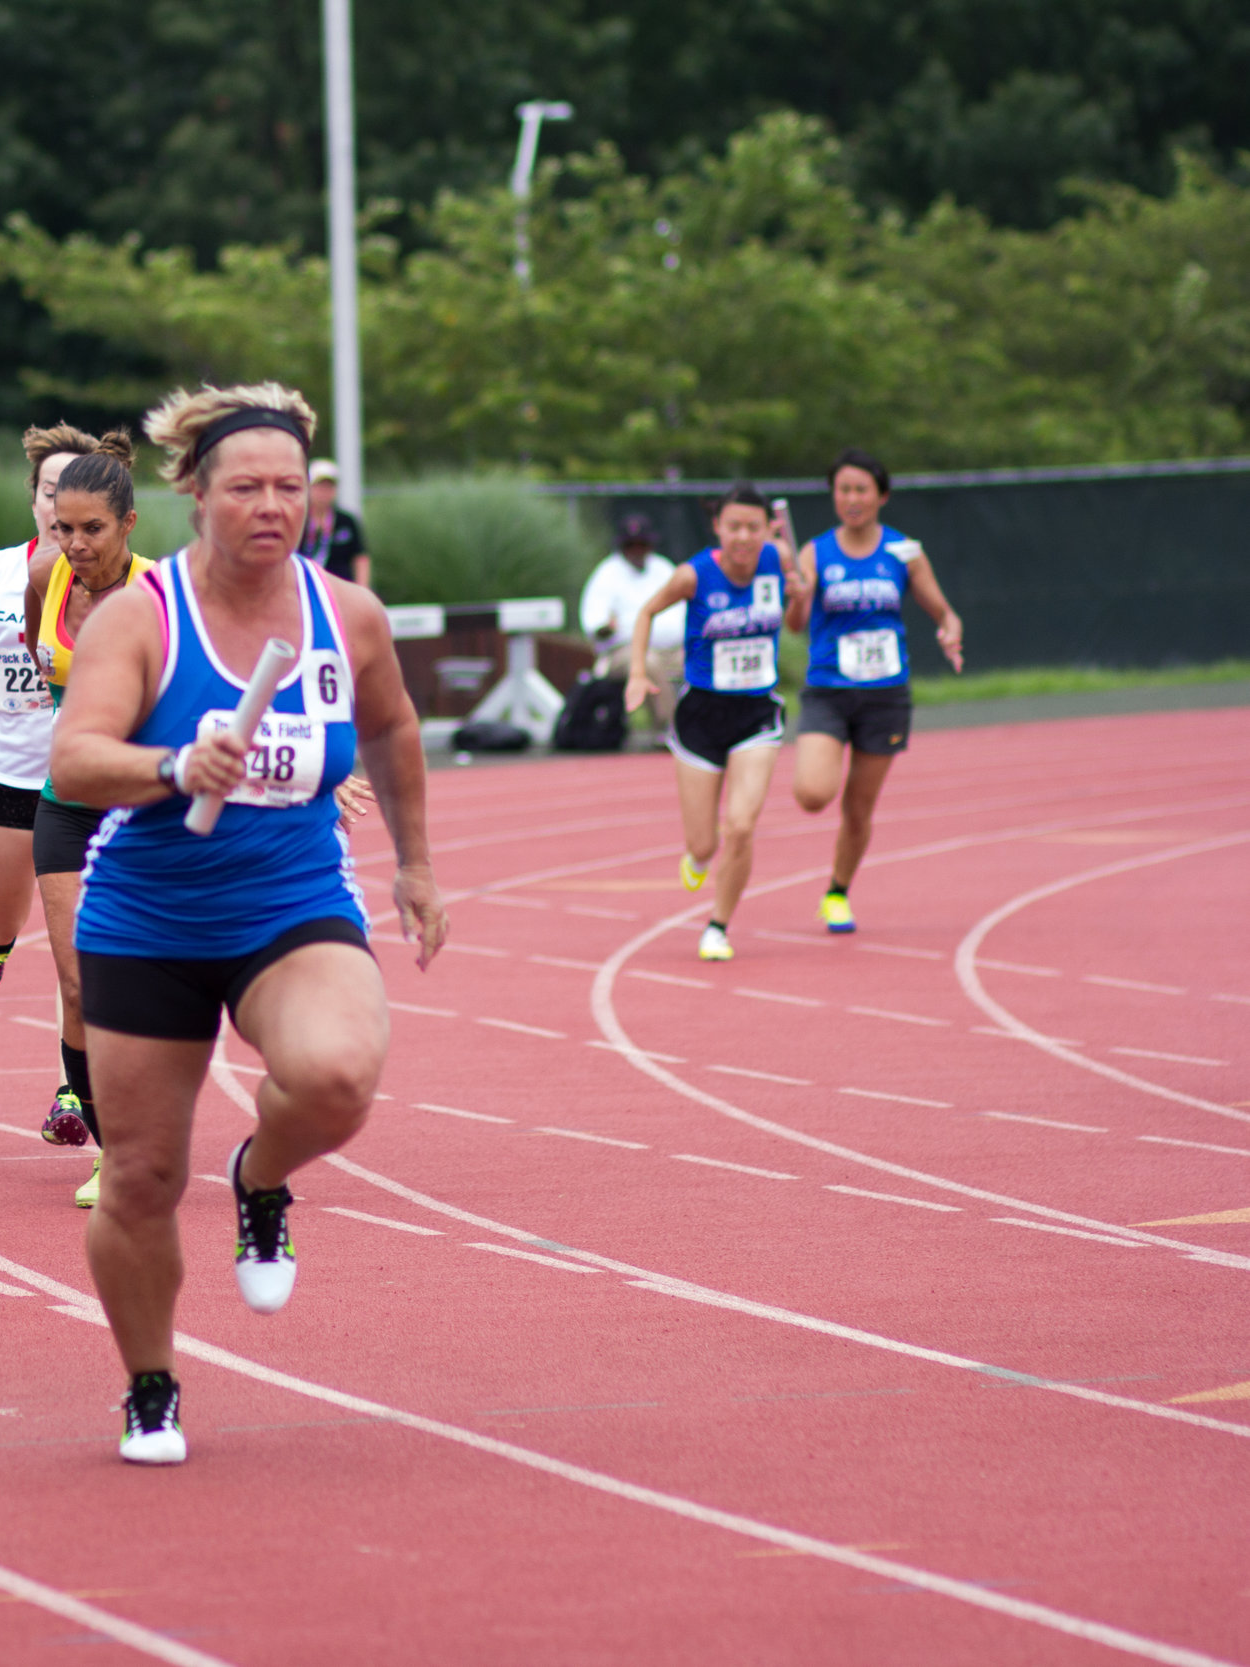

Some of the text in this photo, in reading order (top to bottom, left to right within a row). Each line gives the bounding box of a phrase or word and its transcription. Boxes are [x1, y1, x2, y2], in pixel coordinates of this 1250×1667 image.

[22, 652, 32, 664] &
[318, 664, 338, 704] 6
[279, 723, 312, 739] Field
